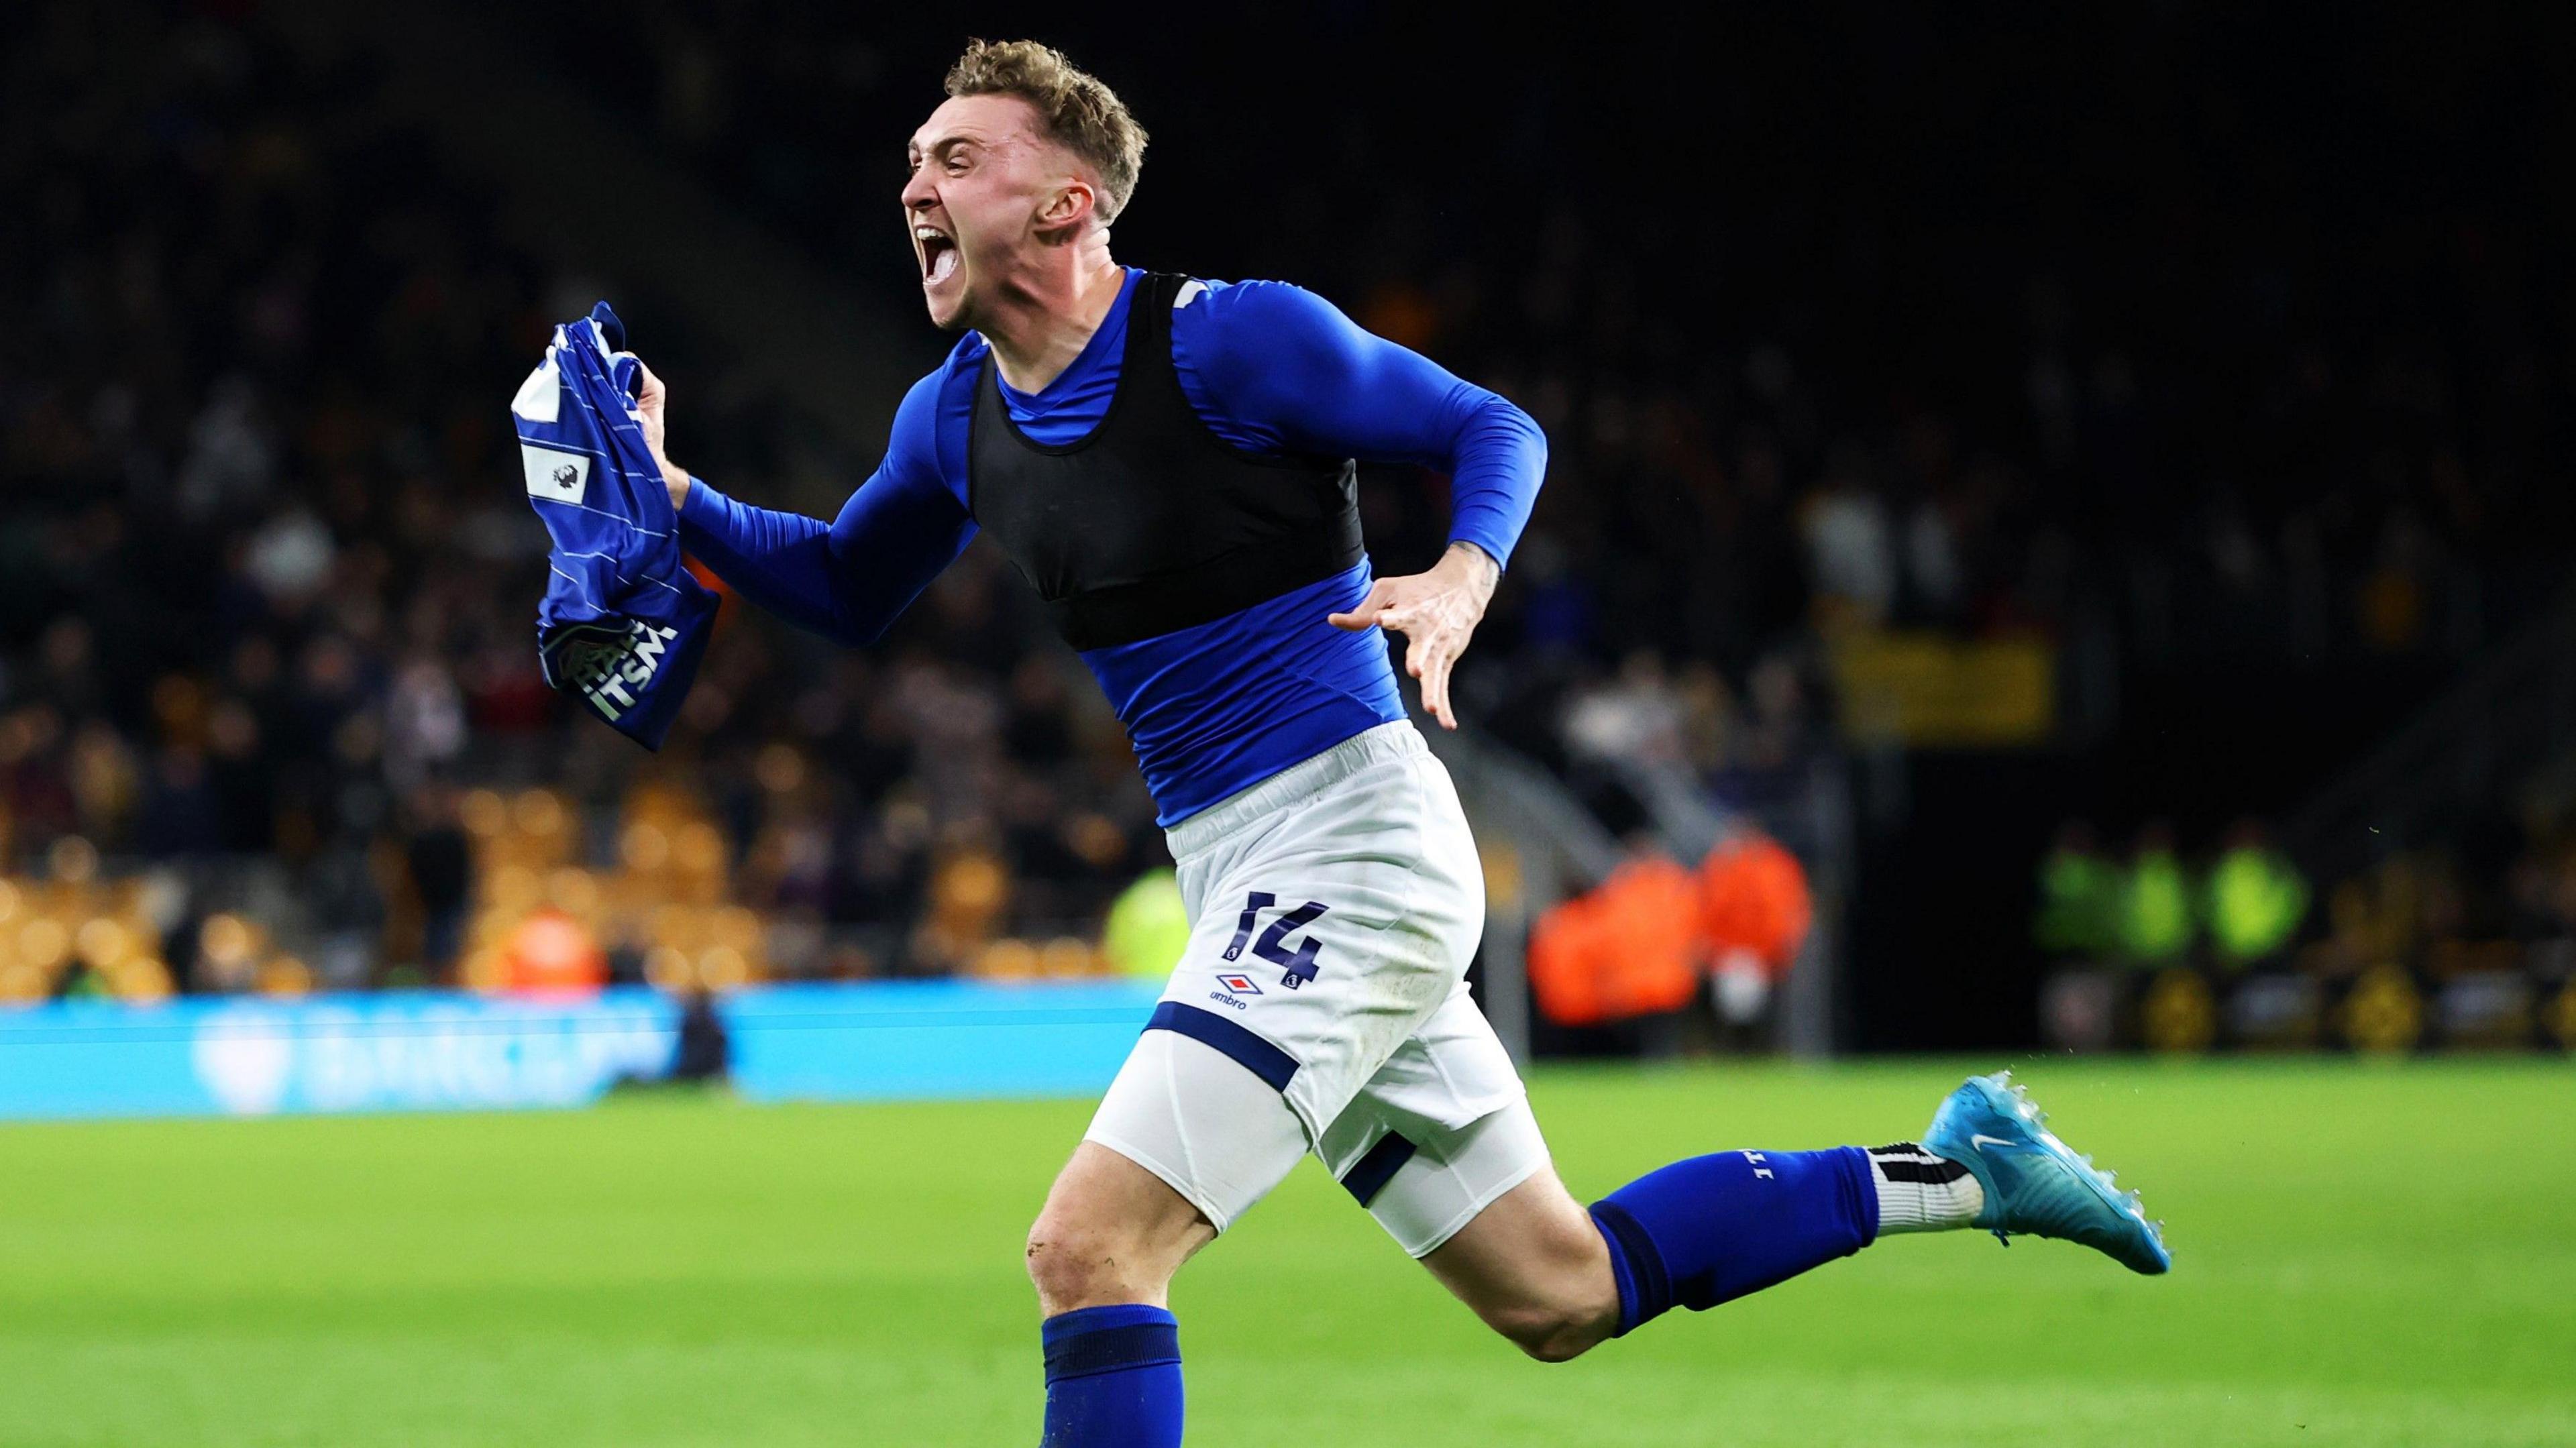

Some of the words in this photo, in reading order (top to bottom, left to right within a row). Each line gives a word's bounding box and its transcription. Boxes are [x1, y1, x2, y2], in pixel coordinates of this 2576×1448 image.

[589, 626, 679, 722] ITSM
[1222, 891, 1330, 990] 14
[1210, 991, 1246, 1010] umbro
